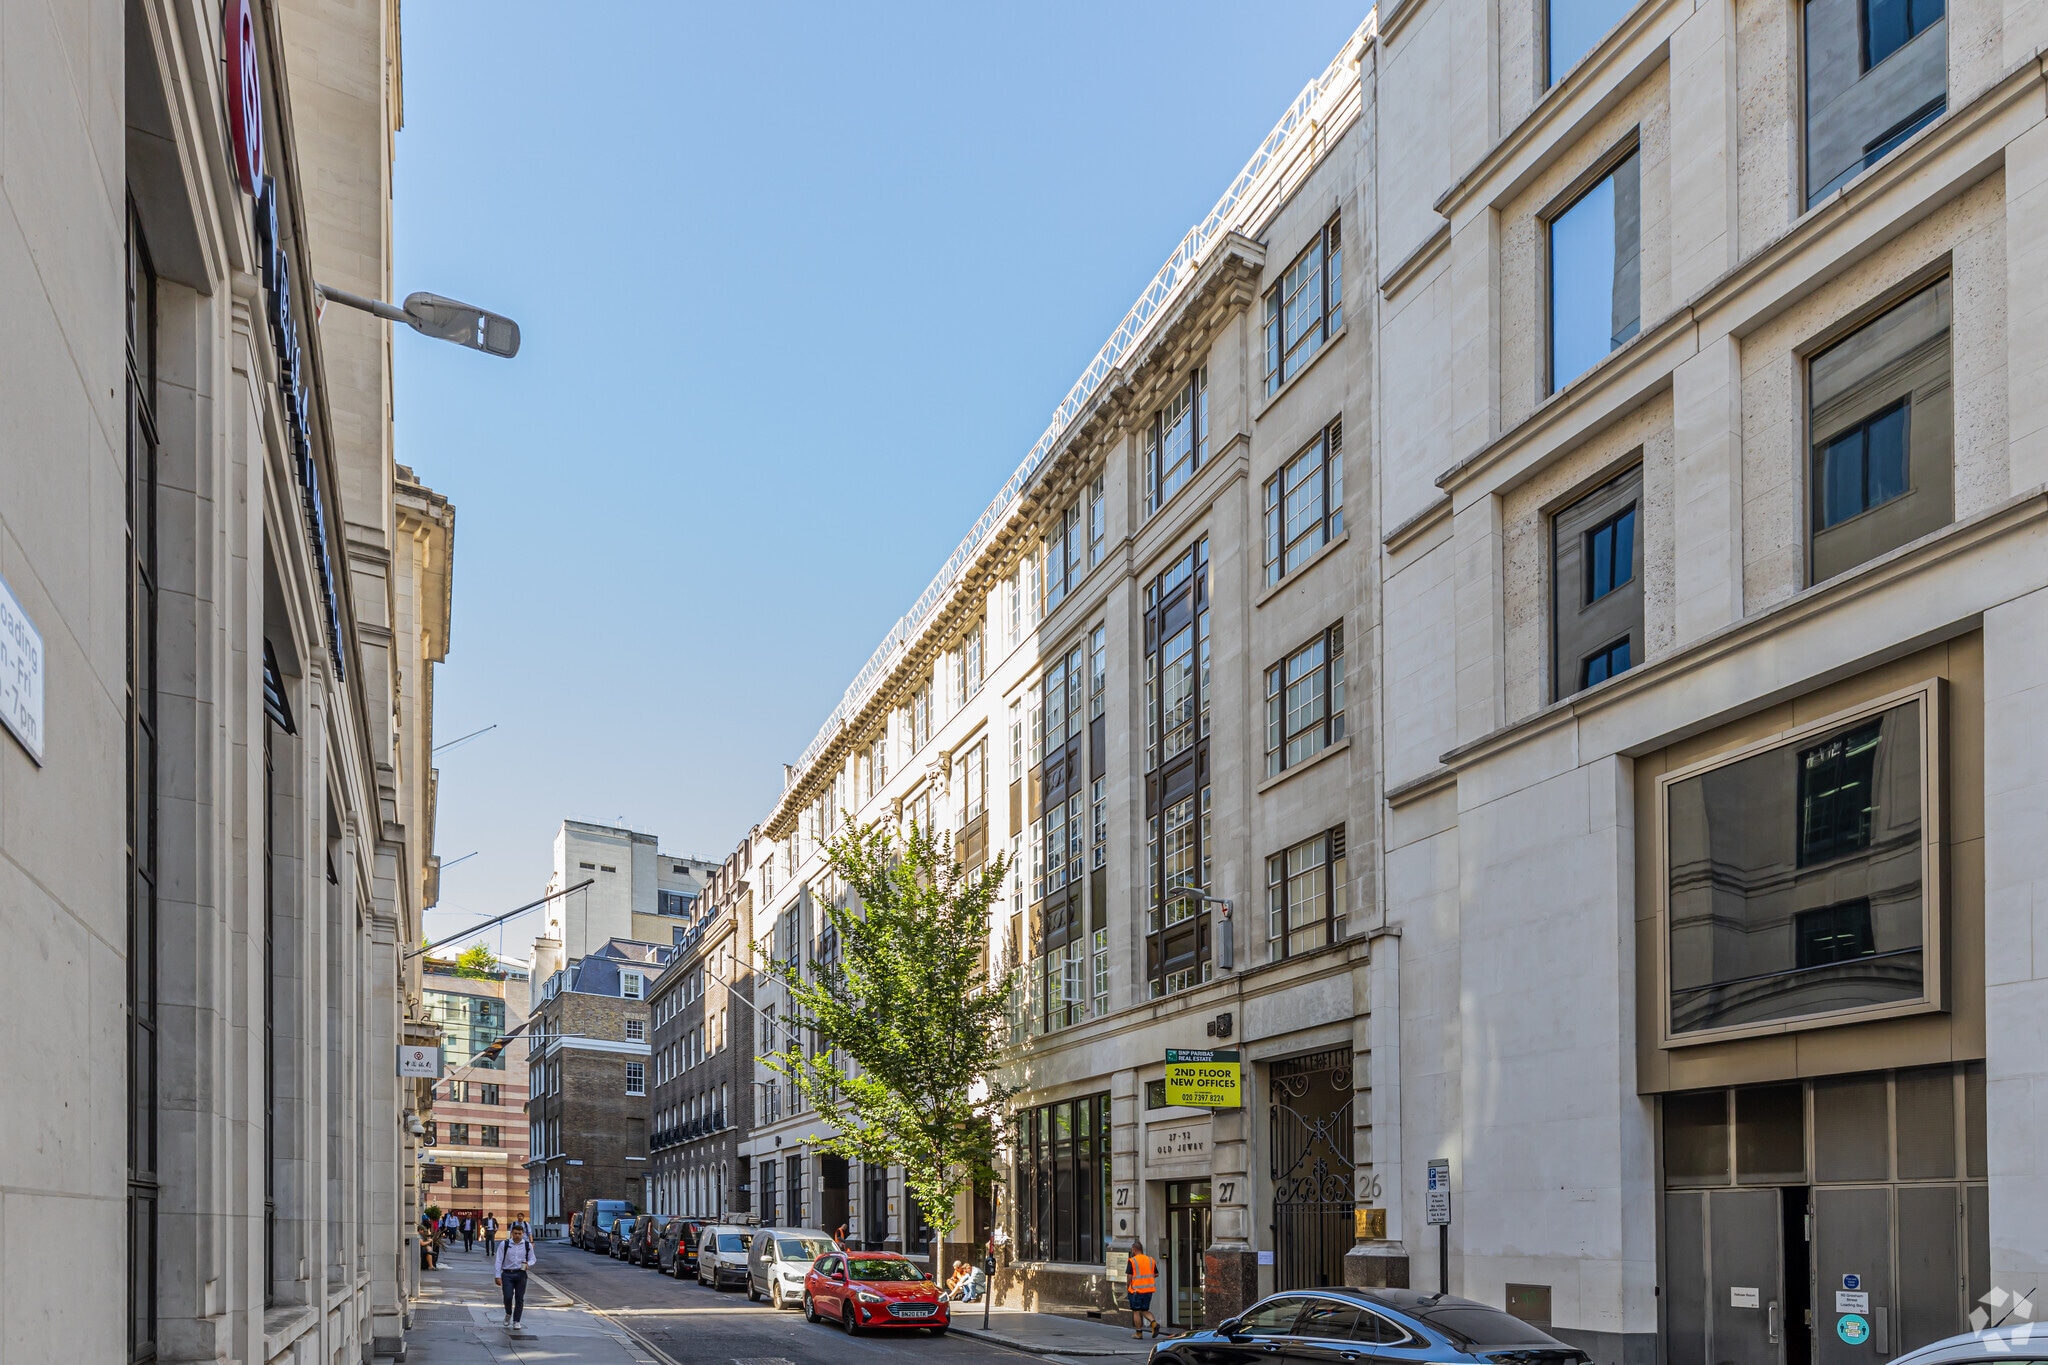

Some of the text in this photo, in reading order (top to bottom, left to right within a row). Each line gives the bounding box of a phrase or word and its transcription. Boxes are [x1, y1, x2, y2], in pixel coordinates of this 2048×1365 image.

[0, 601, 38, 675] oading
[17, 656, 32, 698] Fri
[1174, 1068, 1232, 1078] 2ND FLOOR
[1170, 1078, 1236, 1088] NEW OFFICES
[1182, 1093, 1224, 1102] 020 7397 8224
[1157, 1145, 1172, 1154] OLD
[1218, 1182, 1235, 1203] 27
[1359, 1173, 1382, 1198] 26
[1116, 1188, 1129, 1206] 27
